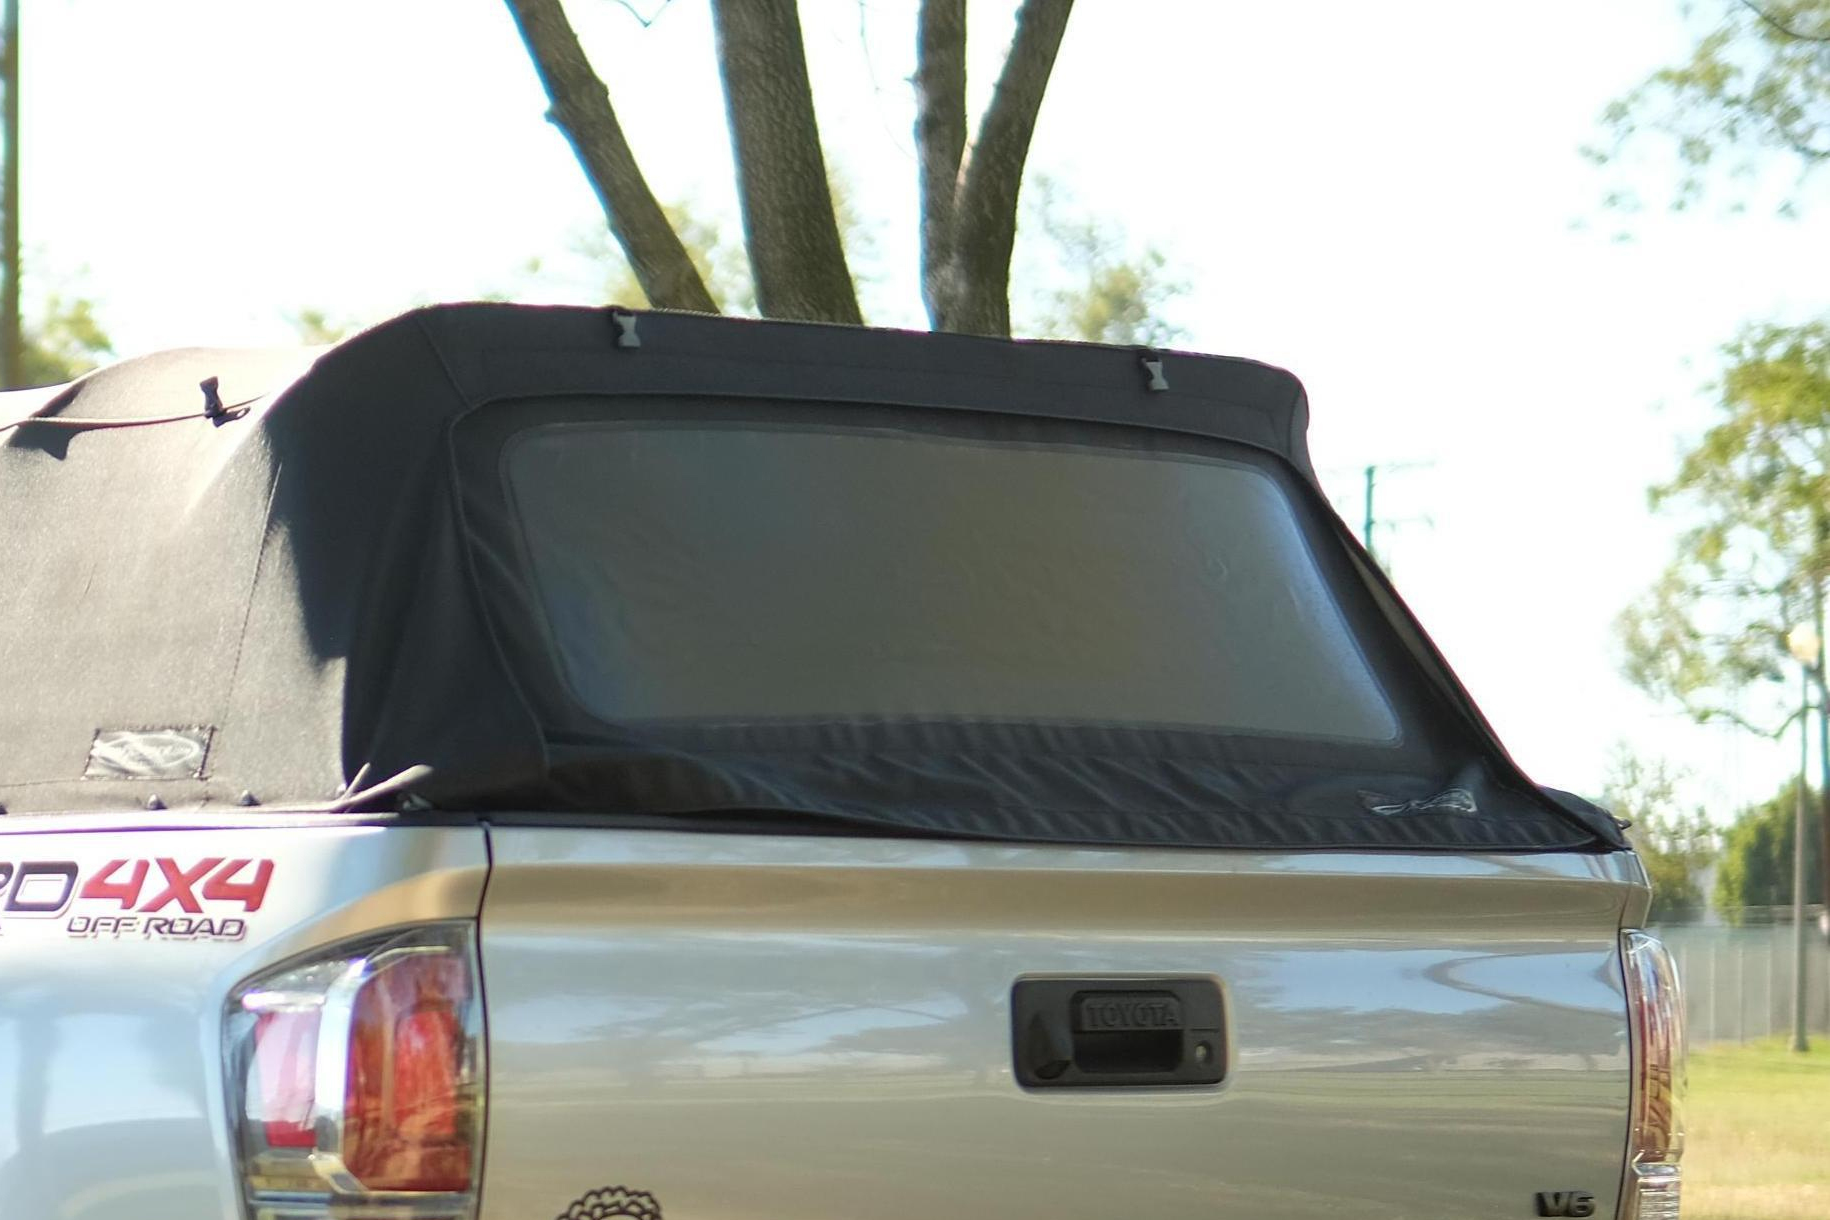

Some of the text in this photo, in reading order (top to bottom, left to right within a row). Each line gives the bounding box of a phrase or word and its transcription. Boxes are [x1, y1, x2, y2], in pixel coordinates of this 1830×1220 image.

[79, 857, 274, 913] 4X4
[67, 916, 248, 940] OFF ROAD
[1086, 1001, 1180, 1028] TOYOTA
[1534, 1191, 1596, 1218] V6
